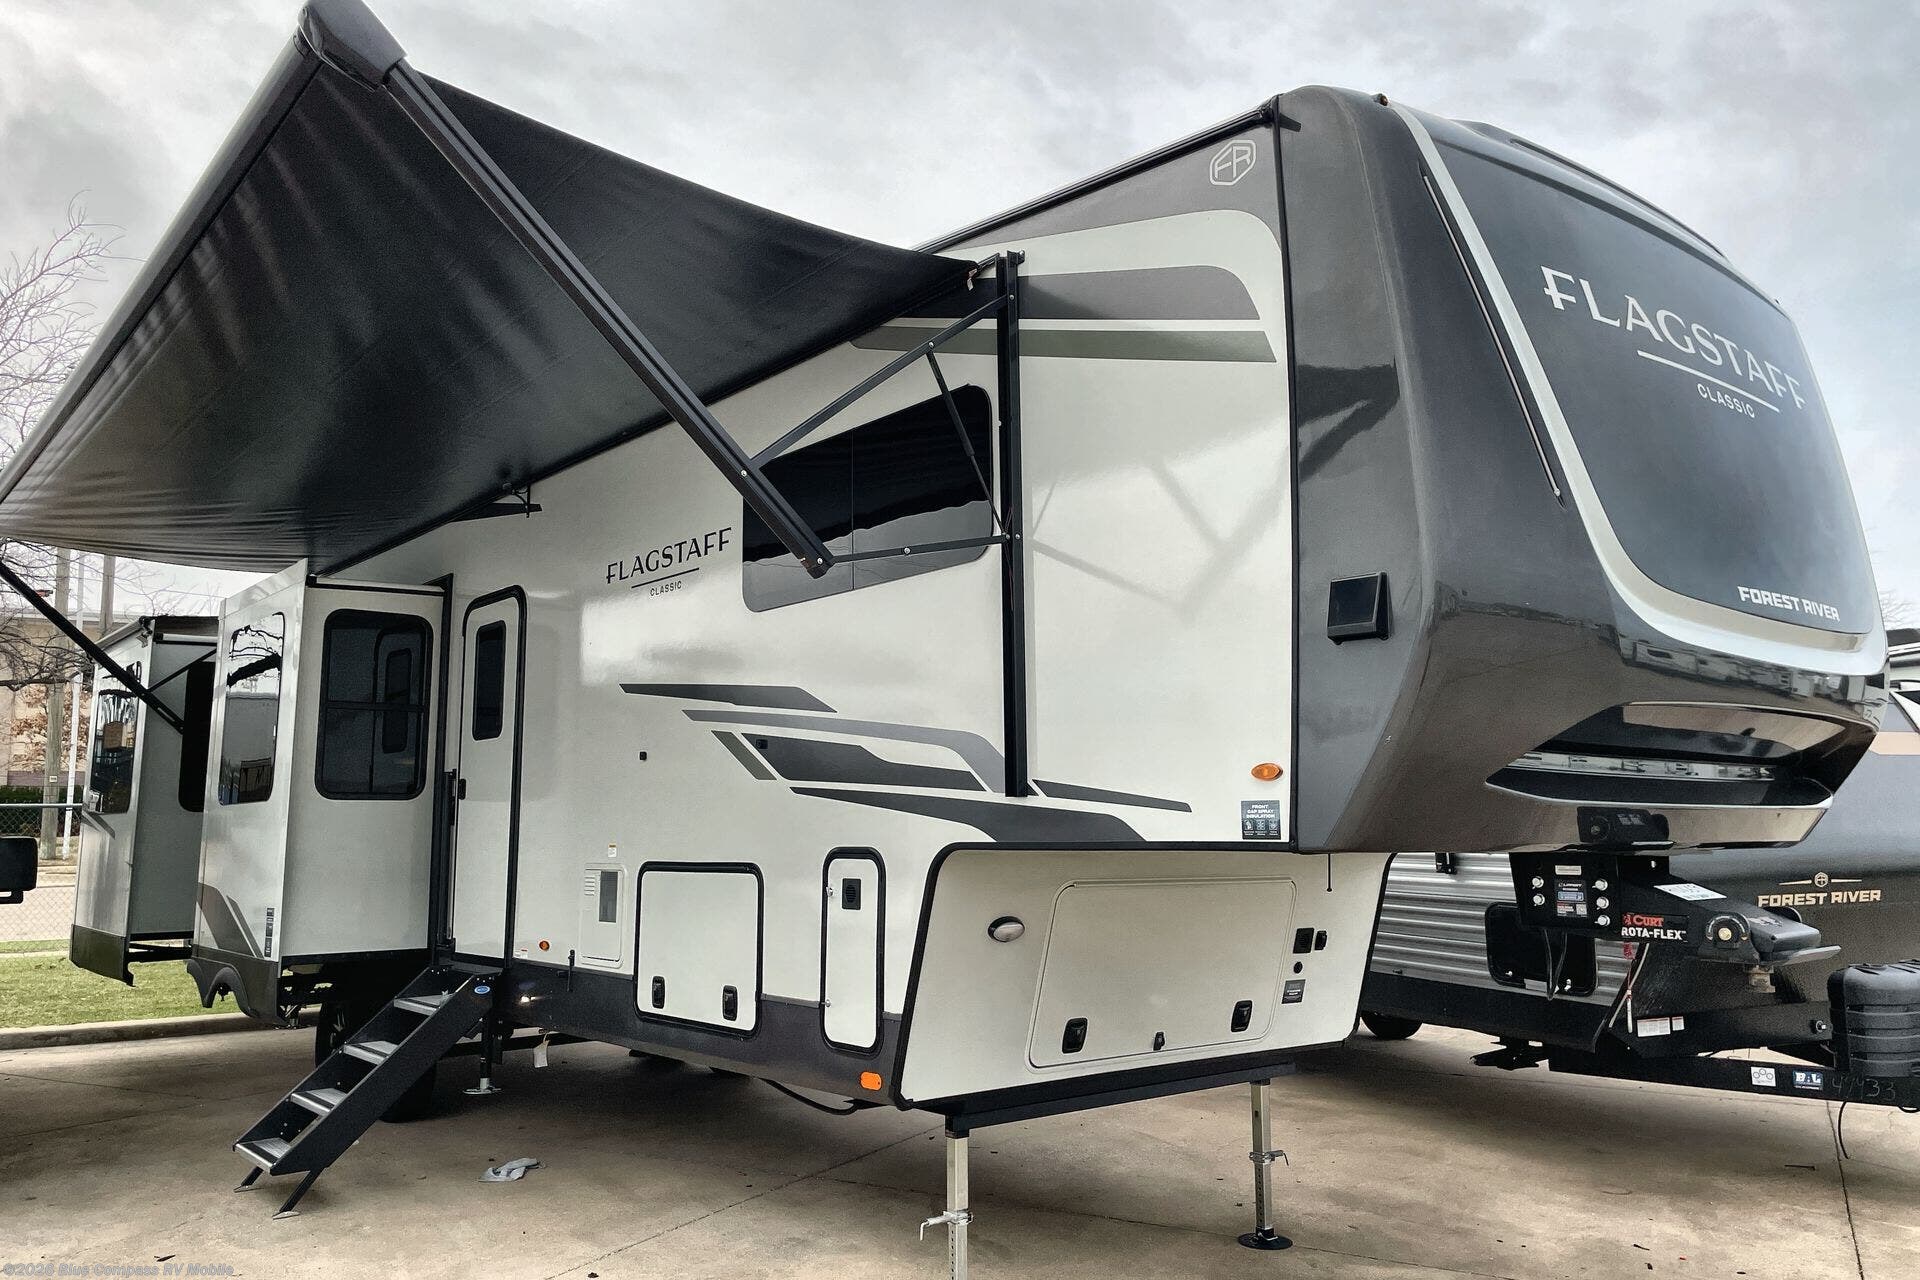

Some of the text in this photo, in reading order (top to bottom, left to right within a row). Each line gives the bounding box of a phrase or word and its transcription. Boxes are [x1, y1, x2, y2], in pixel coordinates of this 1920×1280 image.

[1540, 265, 1807, 409] FLAGSTAFF
[1697, 383, 1755, 418] CLASSIC
[606, 527, 731, 584] FLAGSTAFF
[650, 580, 682, 597] CLASSIC
[1737, 586, 1840, 621] FOREST RIVER
[1757, 889, 1881, 908] FOREST RIVER
